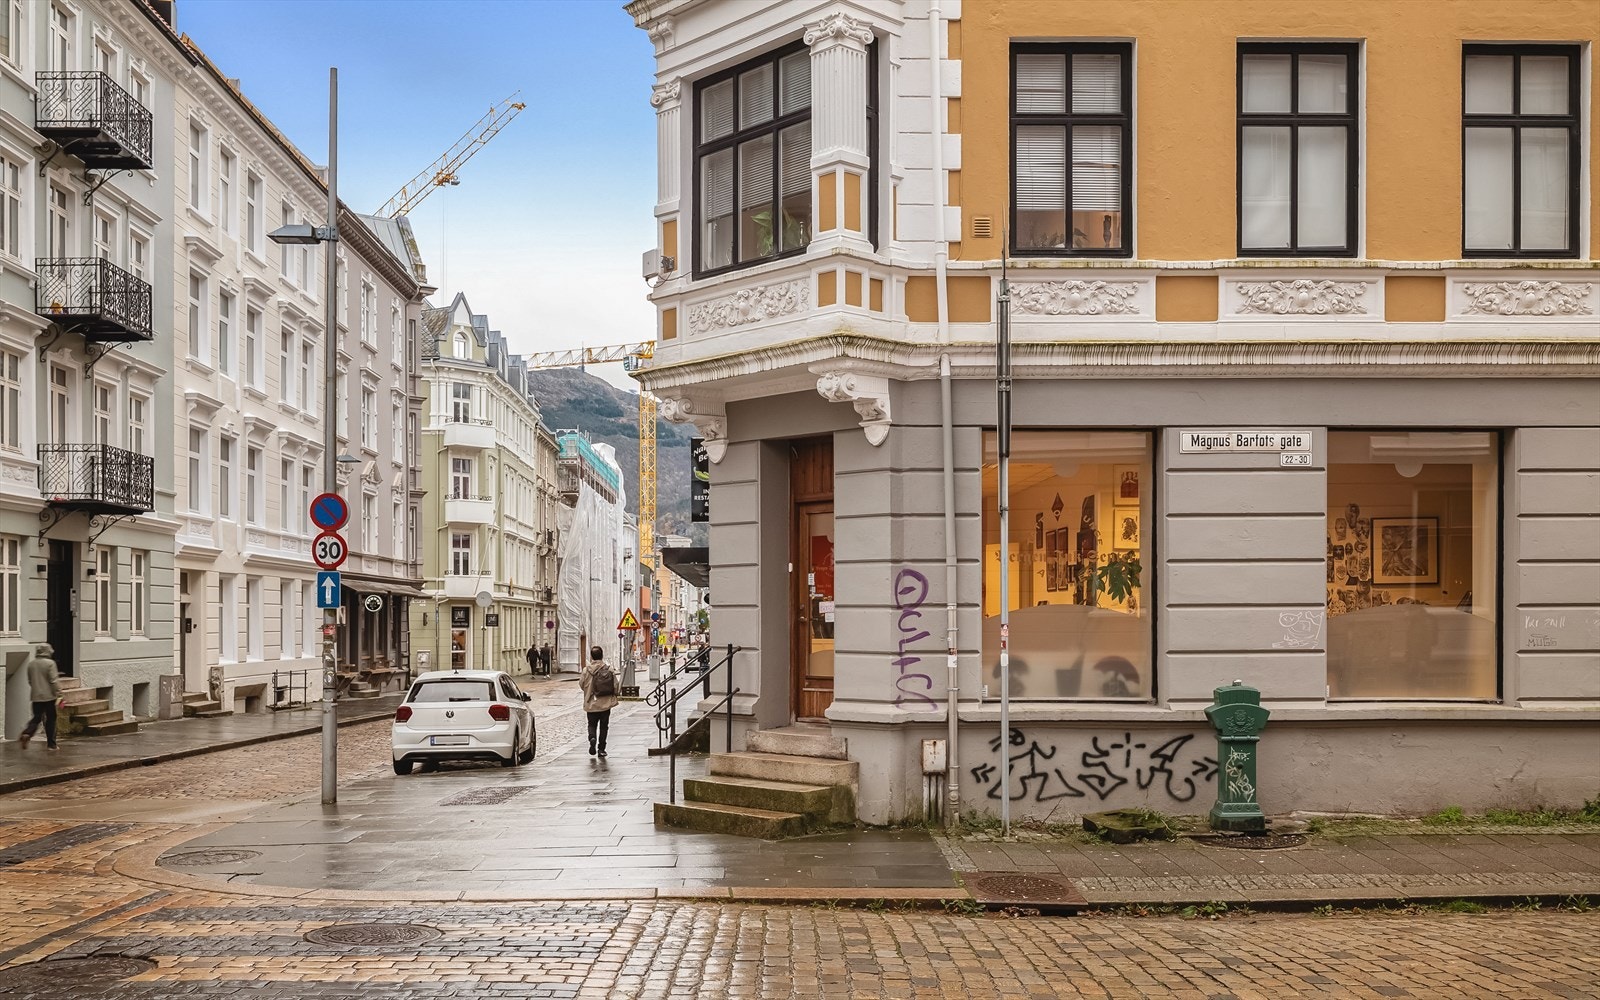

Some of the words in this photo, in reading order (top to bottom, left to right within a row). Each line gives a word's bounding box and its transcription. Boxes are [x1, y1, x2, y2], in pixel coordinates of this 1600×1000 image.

[1190, 434, 1231, 450] Magnus
[1236, 434, 1275, 447] Barfots
[1280, 434, 1302, 450] gate
[318, 541, 341, 560] 30
